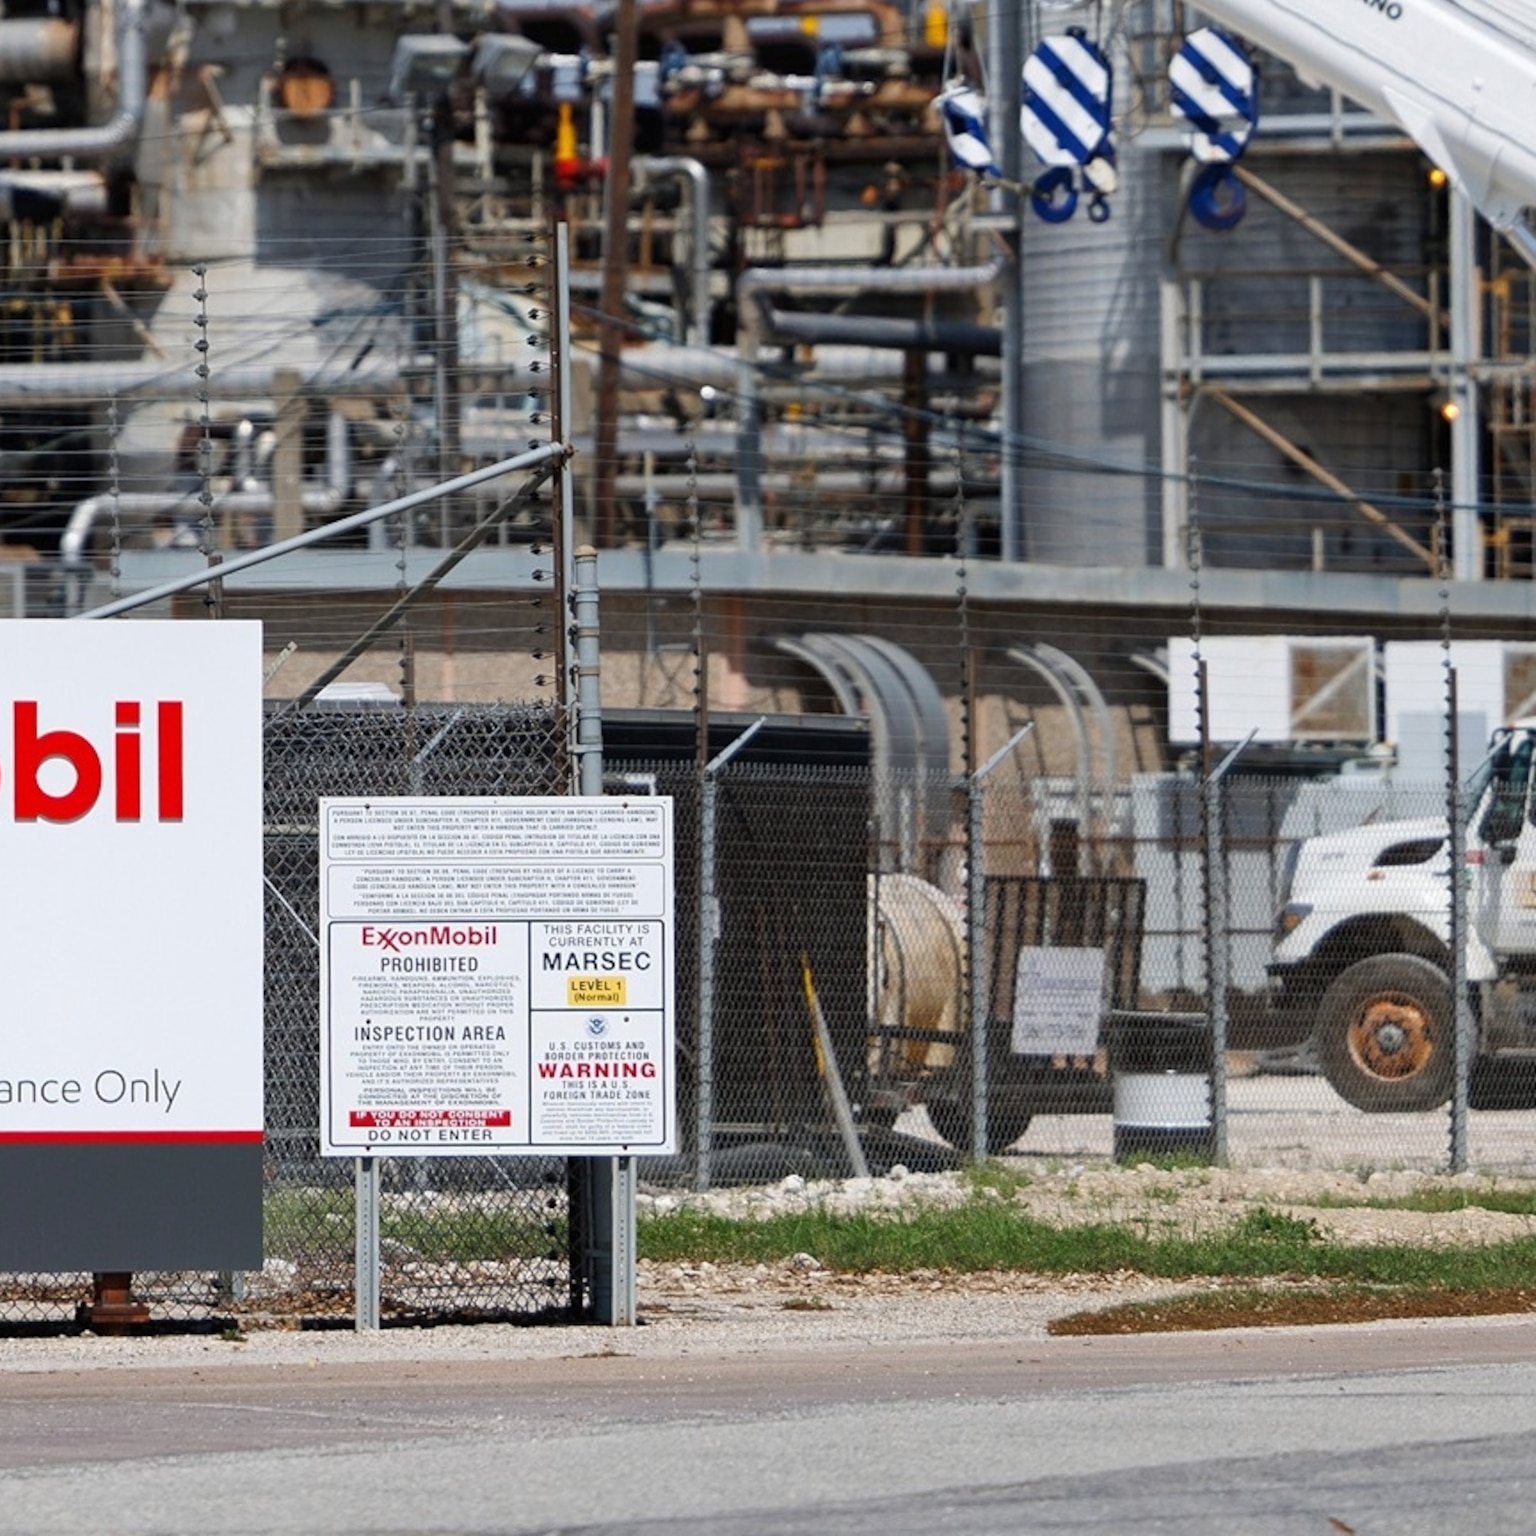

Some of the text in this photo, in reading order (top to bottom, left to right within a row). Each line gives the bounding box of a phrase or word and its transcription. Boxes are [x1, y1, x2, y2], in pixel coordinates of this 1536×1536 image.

[543, 924, 650, 935] THIS FACILITY IS
[362, 926, 497, 953] ExxonMobil
[548, 936, 644, 947] CURRENTLY AT
[381, 956, 478, 973] PROHIBITED
[543, 951, 650, 971] MARSEC
[571, 980, 621, 991] LEVEL 1
[574, 993, 619, 1002] (Normal)
[355, 1025, 505, 1042] INSPECTION AREA
[549, 1041, 645, 1051] U.S. CUSTOMS AND
[544, 1051, 650, 1061] BORDER PROTECTION
[538, 1063, 656, 1078] WARNING
[562, 1080, 631, 1089] THIS IS A U.S.
[94, 1069, 181, 1112] Only
[543, 1090, 650, 1100] FOREIGN TRADE ZONE
[356, 1111, 504, 1119] IF YOU DO NOT CONSENT
[368, 1129, 492, 1142] DO NOT ENTER
